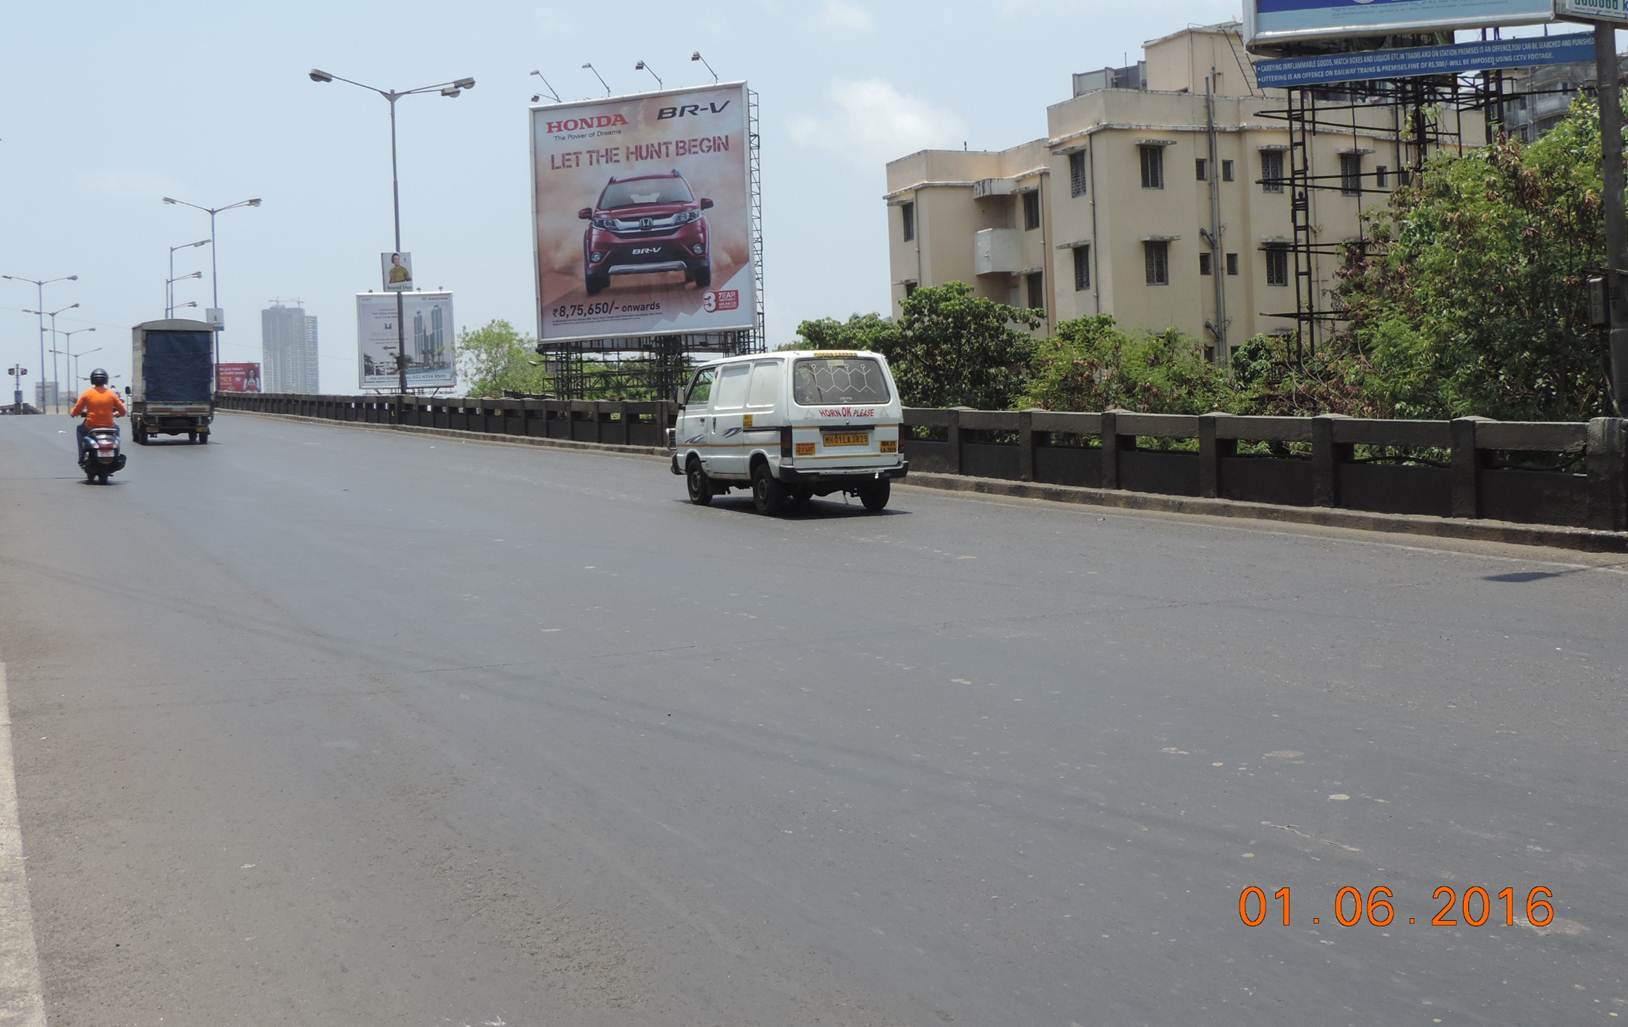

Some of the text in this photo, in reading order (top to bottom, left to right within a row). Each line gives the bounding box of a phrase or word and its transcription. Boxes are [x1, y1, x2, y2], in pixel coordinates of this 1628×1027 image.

[1332, 57, 1348, 66] MATCH
[1350, 56, 1362, 65] BOXES
[1362, 55, 1372, 64] AND
[1420, 51, 1430, 59] AND
[1438, 49, 1456, 58] STATION
[1456, 47, 1478, 56] PREMISES
[1520, 43, 1531, 51] CAN
[1260, 73, 1286, 82] LITTERING
[1301, 70, 1324, 79] OFFENCE
[1332, 68, 1356, 76] RAILWAY
[1357, 66, 1376, 74] TRAINS
[1494, 55, 1512, 63] USING
[1512, 54, 1526, 62] CCTV
[657, 100, 730, 120] BR-V
[546, 114, 628, 134] HONDA
[568, 132, 587, 140] Power
[597, 129, 622, 138] Dreams
[551, 135, 730, 170] LET THE HUNT BEGIN
[632, 246, 662, 255] BR-V
[621, 302, 662, 312] onwards
[703, 291, 717, 312] 3
[818, 406, 875, 417] HORN OK PLEASE
